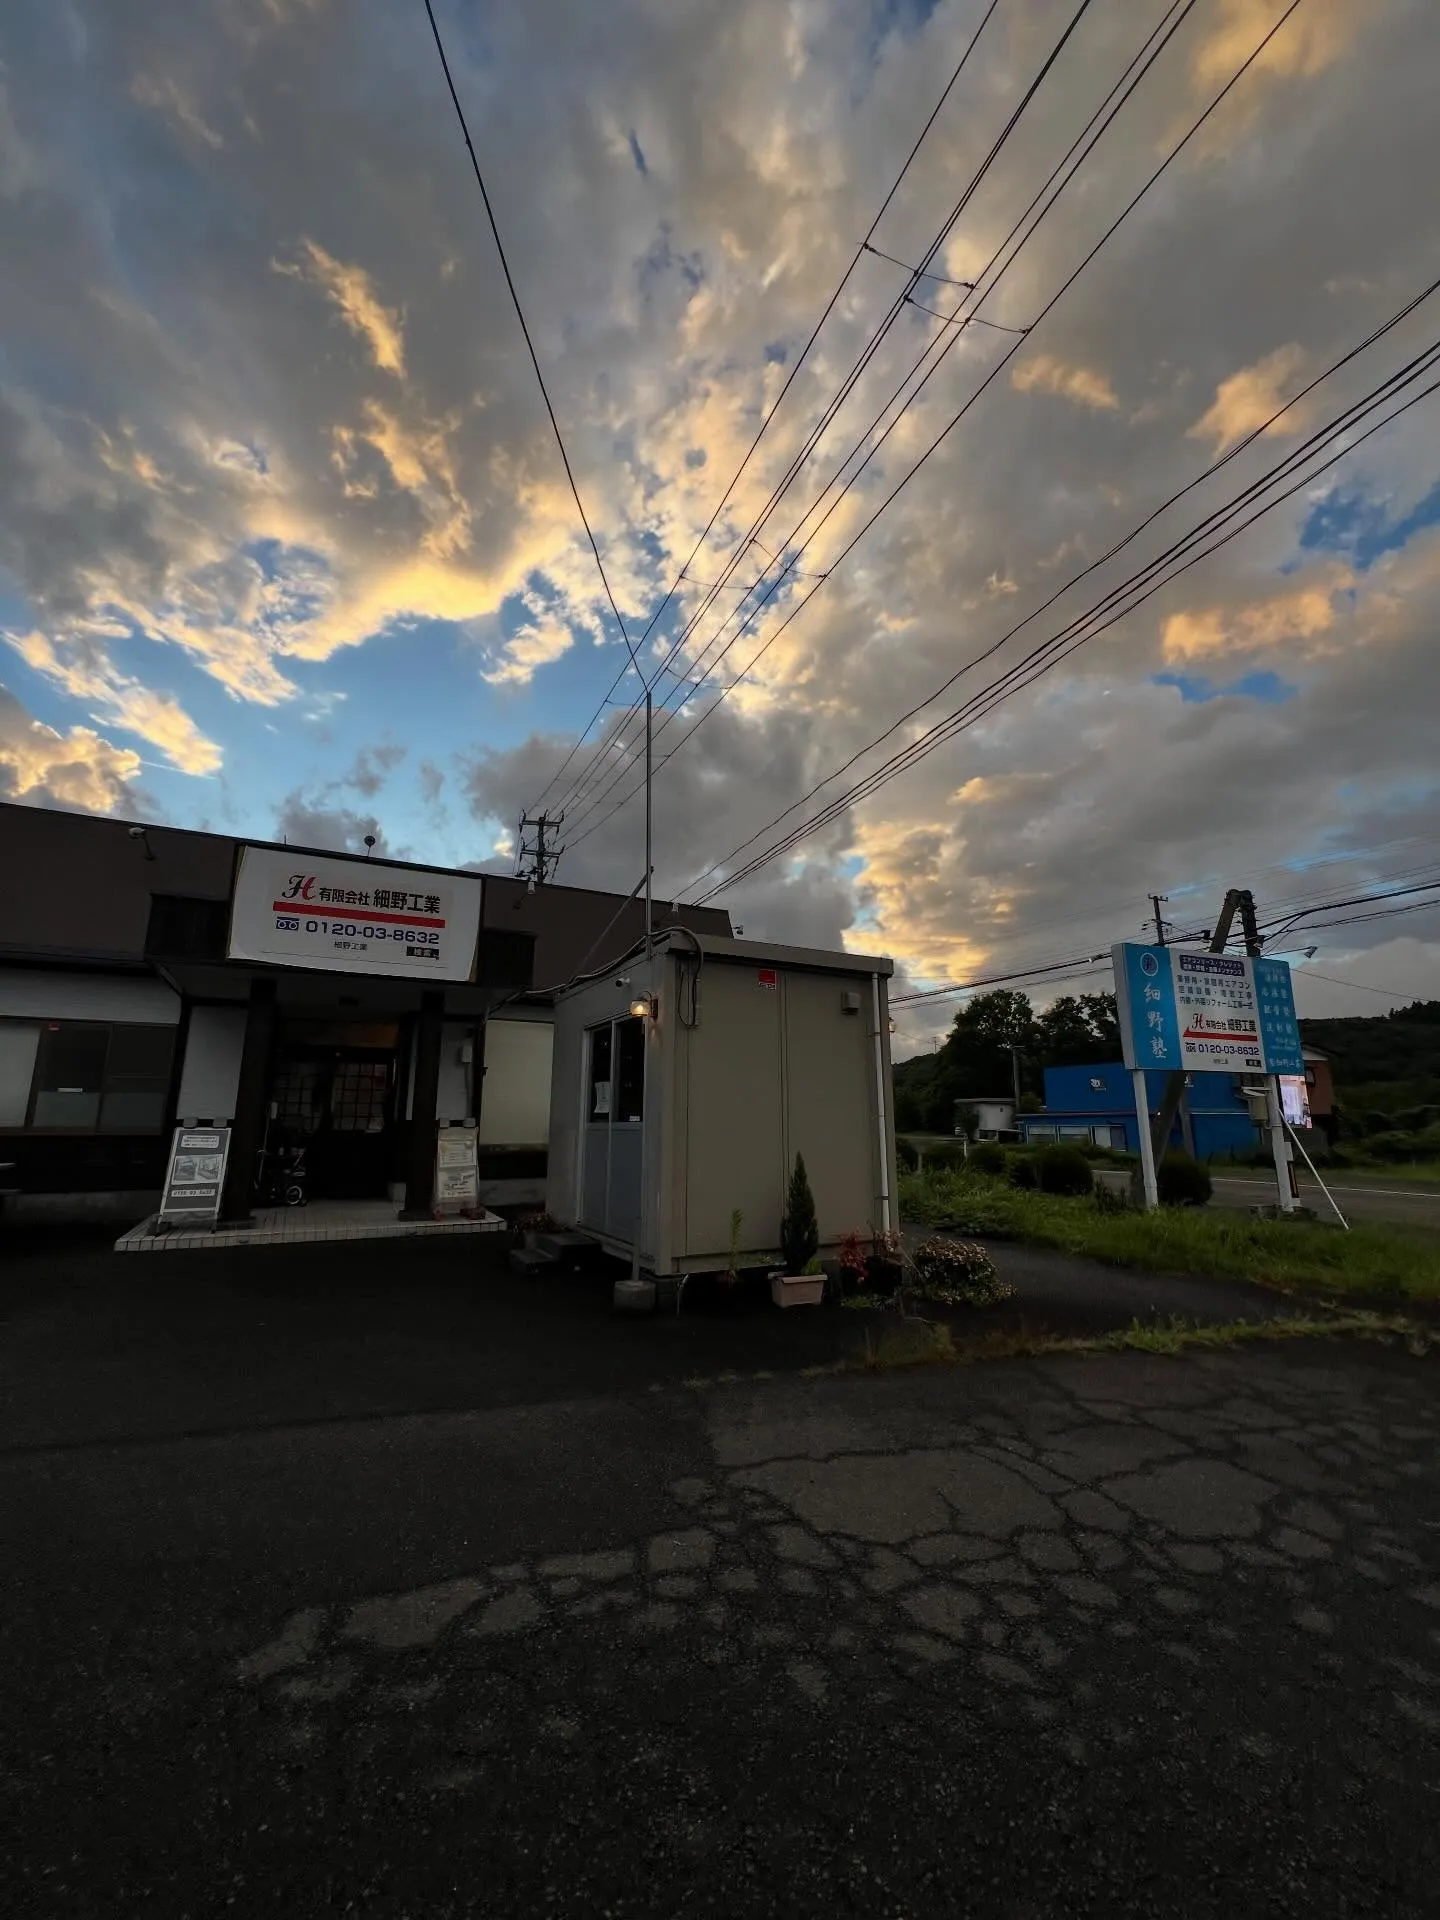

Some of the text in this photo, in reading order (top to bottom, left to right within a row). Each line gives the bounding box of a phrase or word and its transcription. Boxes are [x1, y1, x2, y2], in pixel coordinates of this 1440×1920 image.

[319, 887, 371, 906] 有限会社
[373, 888, 441, 914] 細野工業
[305, 920, 440, 945] 0120-03-8632
[1205, 1020, 1227, 1031] 有限会社
[1227, 1019, 1257, 1033] 細野工業
[1198, 1043, 1260, 1056] 0120-03-8632
